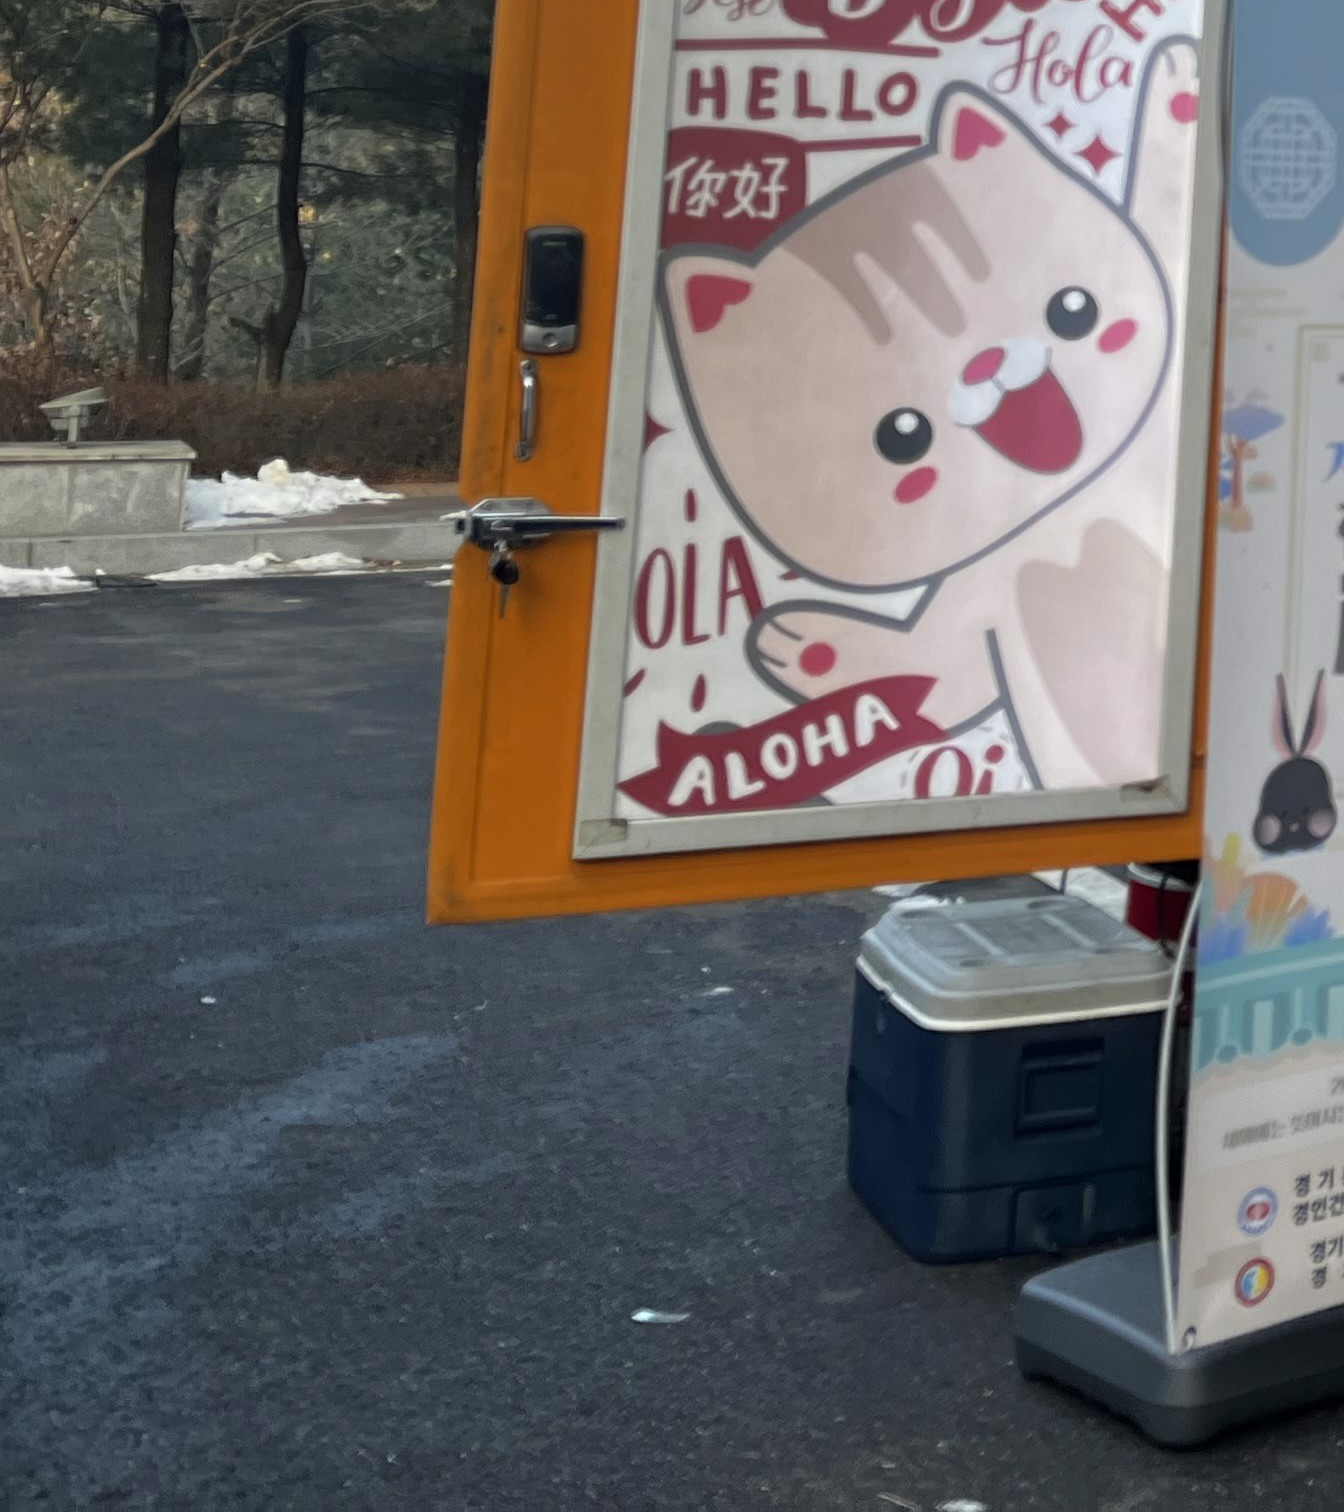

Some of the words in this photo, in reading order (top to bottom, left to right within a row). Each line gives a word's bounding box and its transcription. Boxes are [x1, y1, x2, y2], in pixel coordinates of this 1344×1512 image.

[685, 65, 919, 121] HELLO
[980, 18, 1136, 105] Hola
[664, 155, 790, 219] 你好
[667, 693, 900, 807] ALOHA
